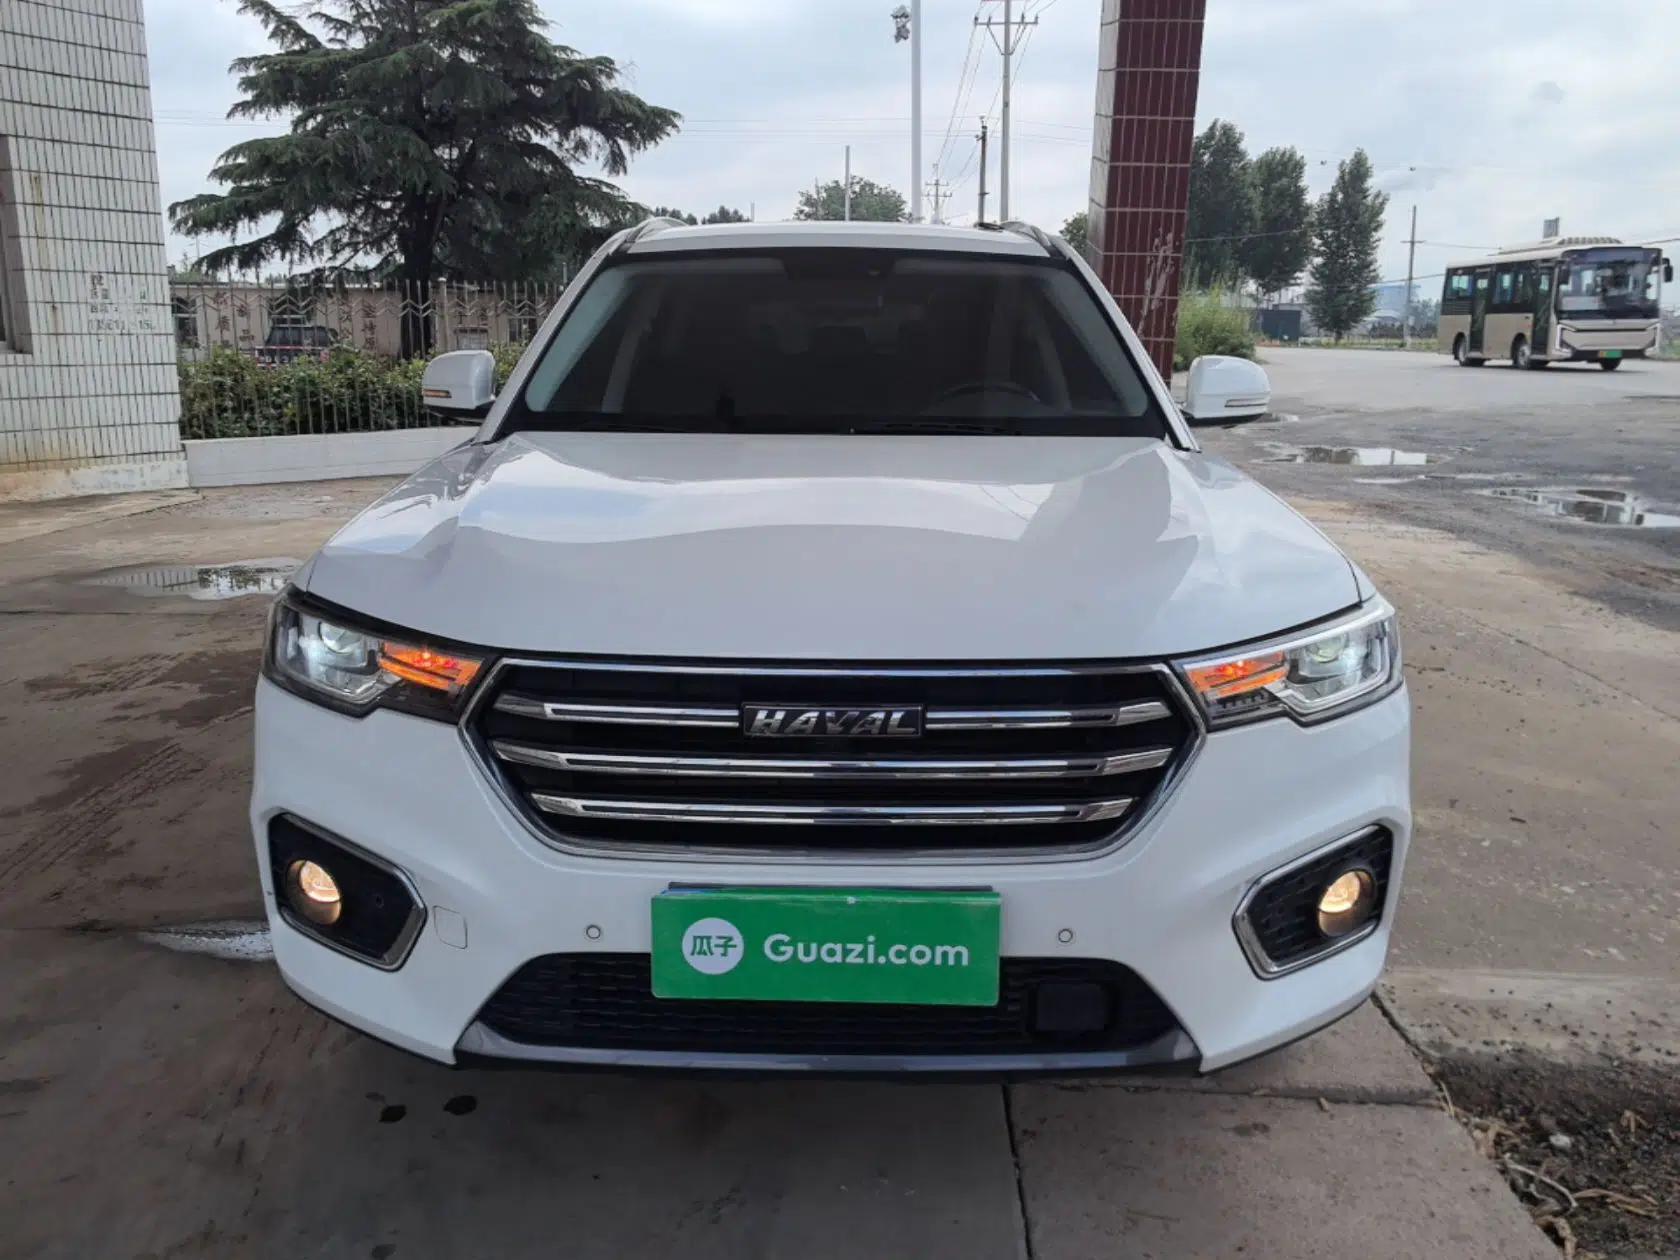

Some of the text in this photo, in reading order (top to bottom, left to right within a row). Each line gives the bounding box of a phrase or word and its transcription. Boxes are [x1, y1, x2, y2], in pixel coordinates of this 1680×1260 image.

[749, 709, 917, 735] HAVAL
[690, 935, 737, 957] 瓜子
[763, 933, 969, 967] Guazi.com
